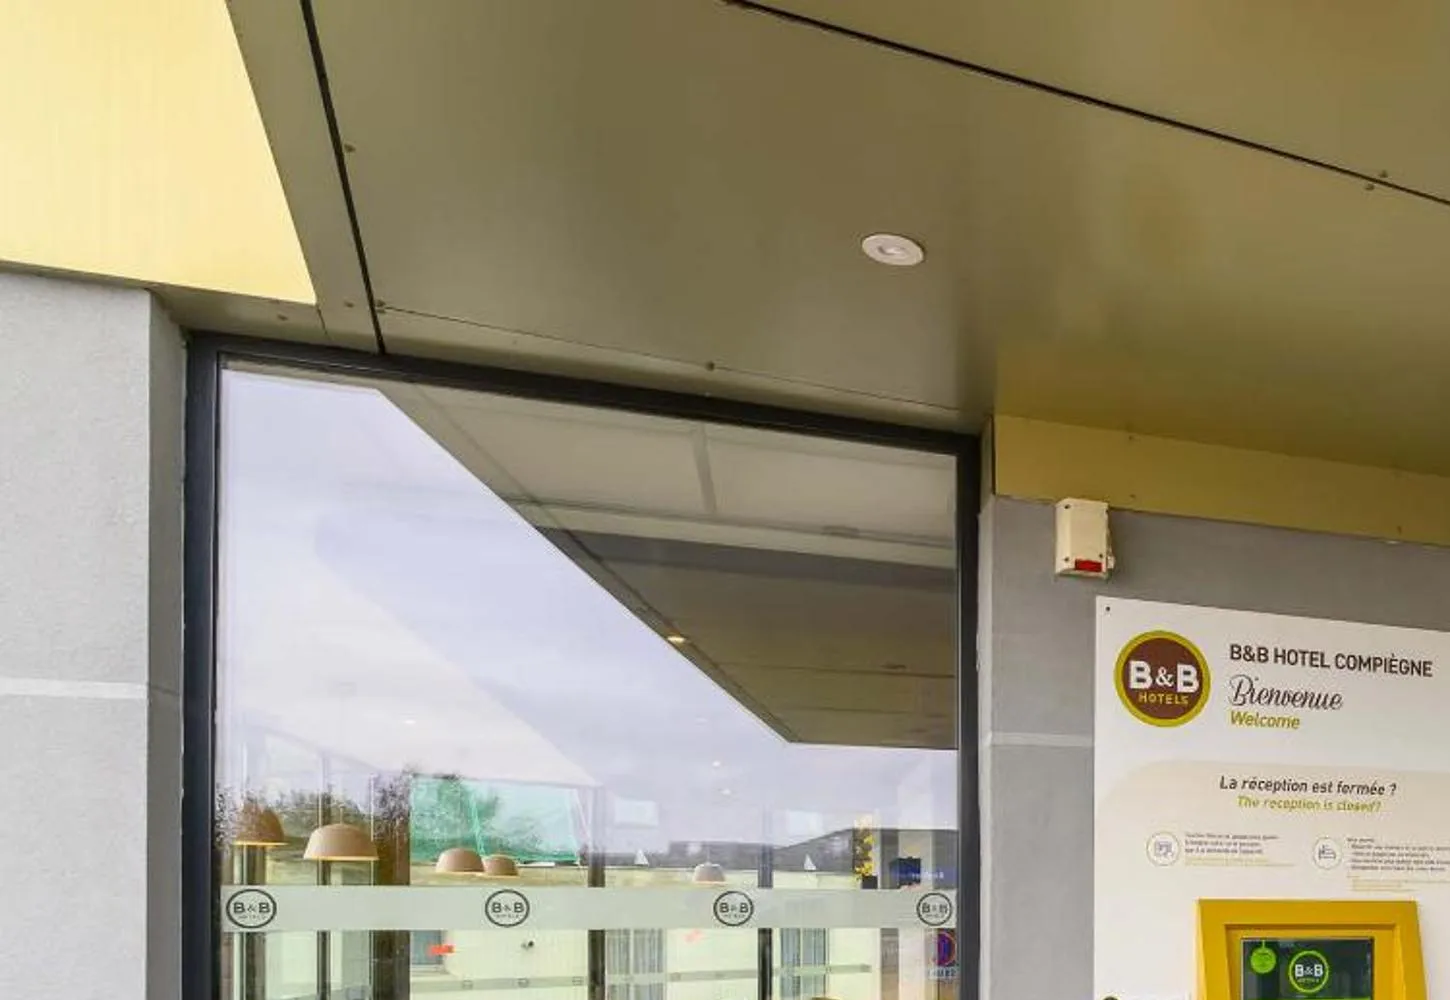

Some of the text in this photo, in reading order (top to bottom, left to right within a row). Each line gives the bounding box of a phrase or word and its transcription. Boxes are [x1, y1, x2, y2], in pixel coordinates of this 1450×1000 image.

[1229, 644, 1433, 677] B&B HOTEL COMPIÈGNE
[1129, 660, 1199, 693] B&B
[1138, 692, 1189, 705] HOTELS
[1229, 674, 1344, 711] Bienvenue
[1230, 711, 1300, 730] Welcome
[1219, 775, 1238, 790] La
[1241, 776, 1307, 795] réception
[1312, 781, 1333, 794] est
[1337, 780, 1385, 796] fermée
[1238, 795, 1257, 808] The
[1264, 798, 1323, 812] reception
[1324, 800, 1333, 811] is
[233, 902, 269, 914] B&B
[492, 902, 524, 913] B&B
[1294, 963, 1324, 978] B&B
